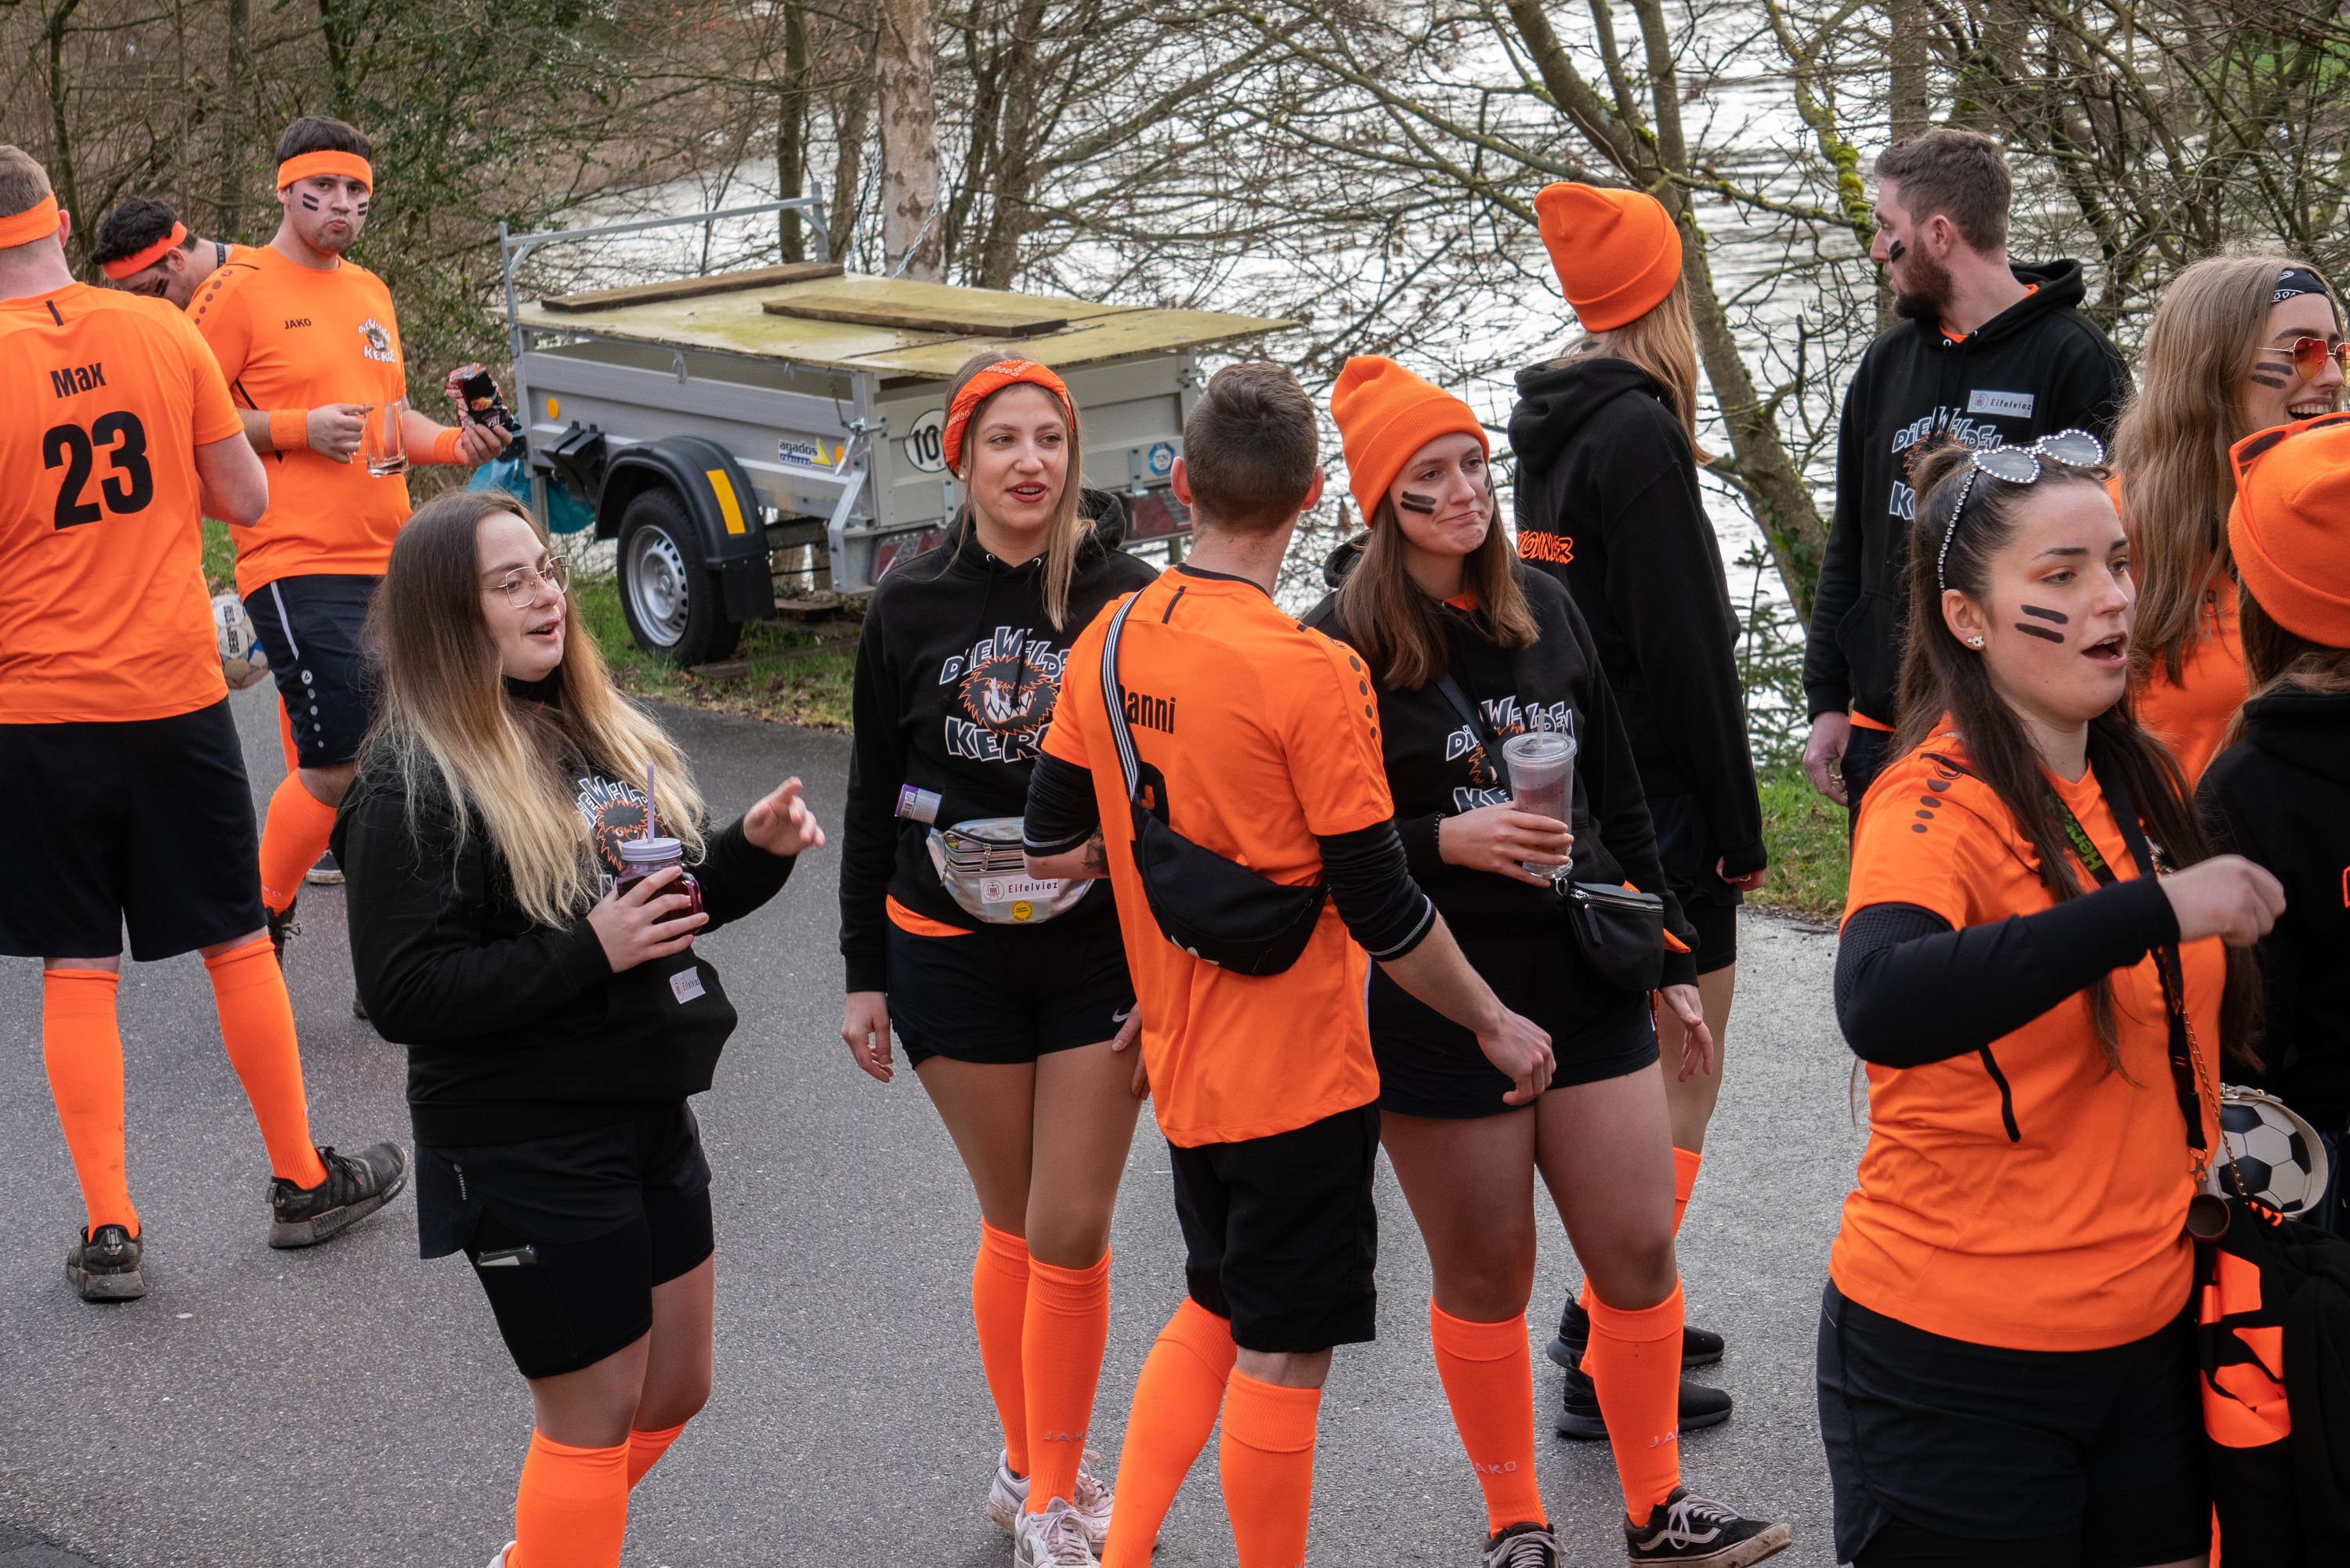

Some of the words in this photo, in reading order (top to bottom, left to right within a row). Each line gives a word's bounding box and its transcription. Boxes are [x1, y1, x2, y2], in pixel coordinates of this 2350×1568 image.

[284, 318, 312, 330] JAKO
[50, 363, 107, 399] Max
[1990, 398, 2033, 411] Eifelviez
[779, 441, 818, 457] agados
[914, 425, 940, 465] 10
[43, 411, 154, 531] 23
[945, 715, 1050, 764] KER
[1008, 881, 1058, 894] Eifelviez
[1043, 1430, 1088, 1442] JAK
[1649, 1423, 1679, 1448] JA
[1475, 1461, 1517, 1474] AKO
